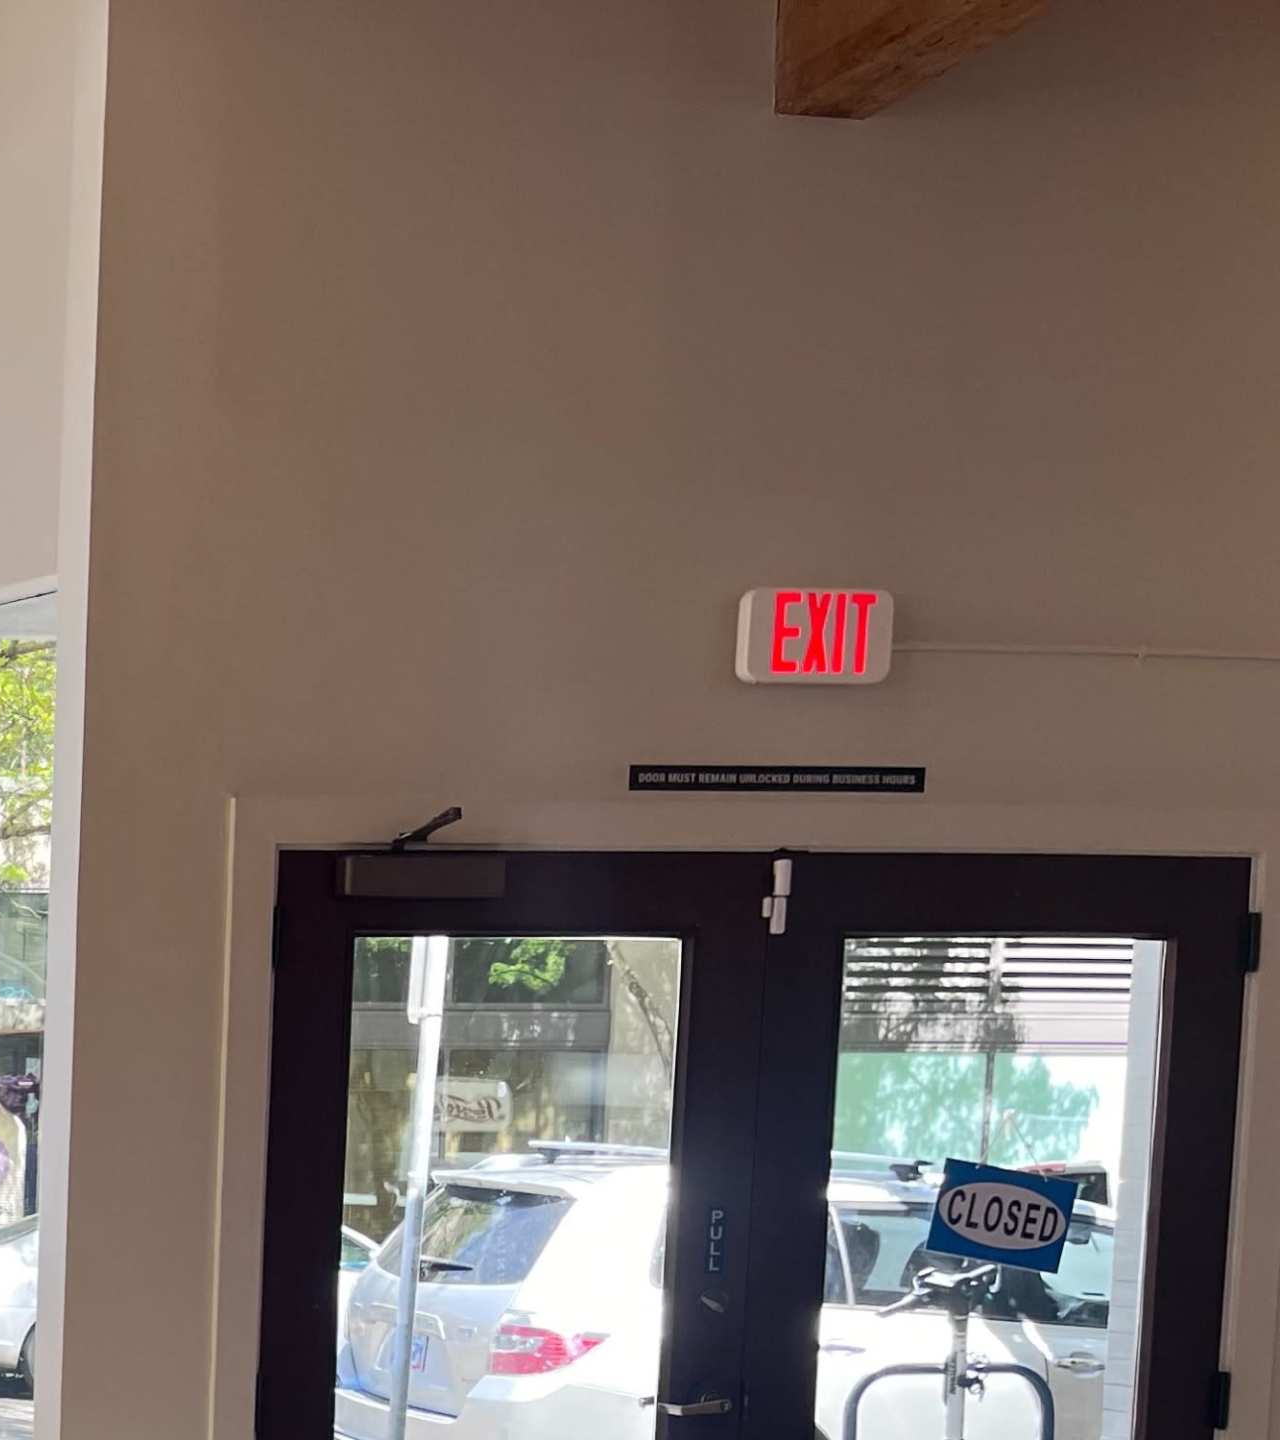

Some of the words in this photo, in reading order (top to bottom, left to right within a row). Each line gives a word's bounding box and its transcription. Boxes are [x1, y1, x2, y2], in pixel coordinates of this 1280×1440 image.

[770, 590, 878, 675] EXIT
[638, 772, 666, 783] DOOR
[668, 772, 697, 783] MUST
[698, 773, 737, 784] REMAIN
[739, 773, 791, 784] UNLOCKED
[792, 774, 830, 785] DURING
[832, 774, 880, 785] BUSINESS
[882, 775, 916, 785] HOURS
[709, 1210, 724, 1272] PULL
[947, 1189, 1058, 1242] CLOSED
